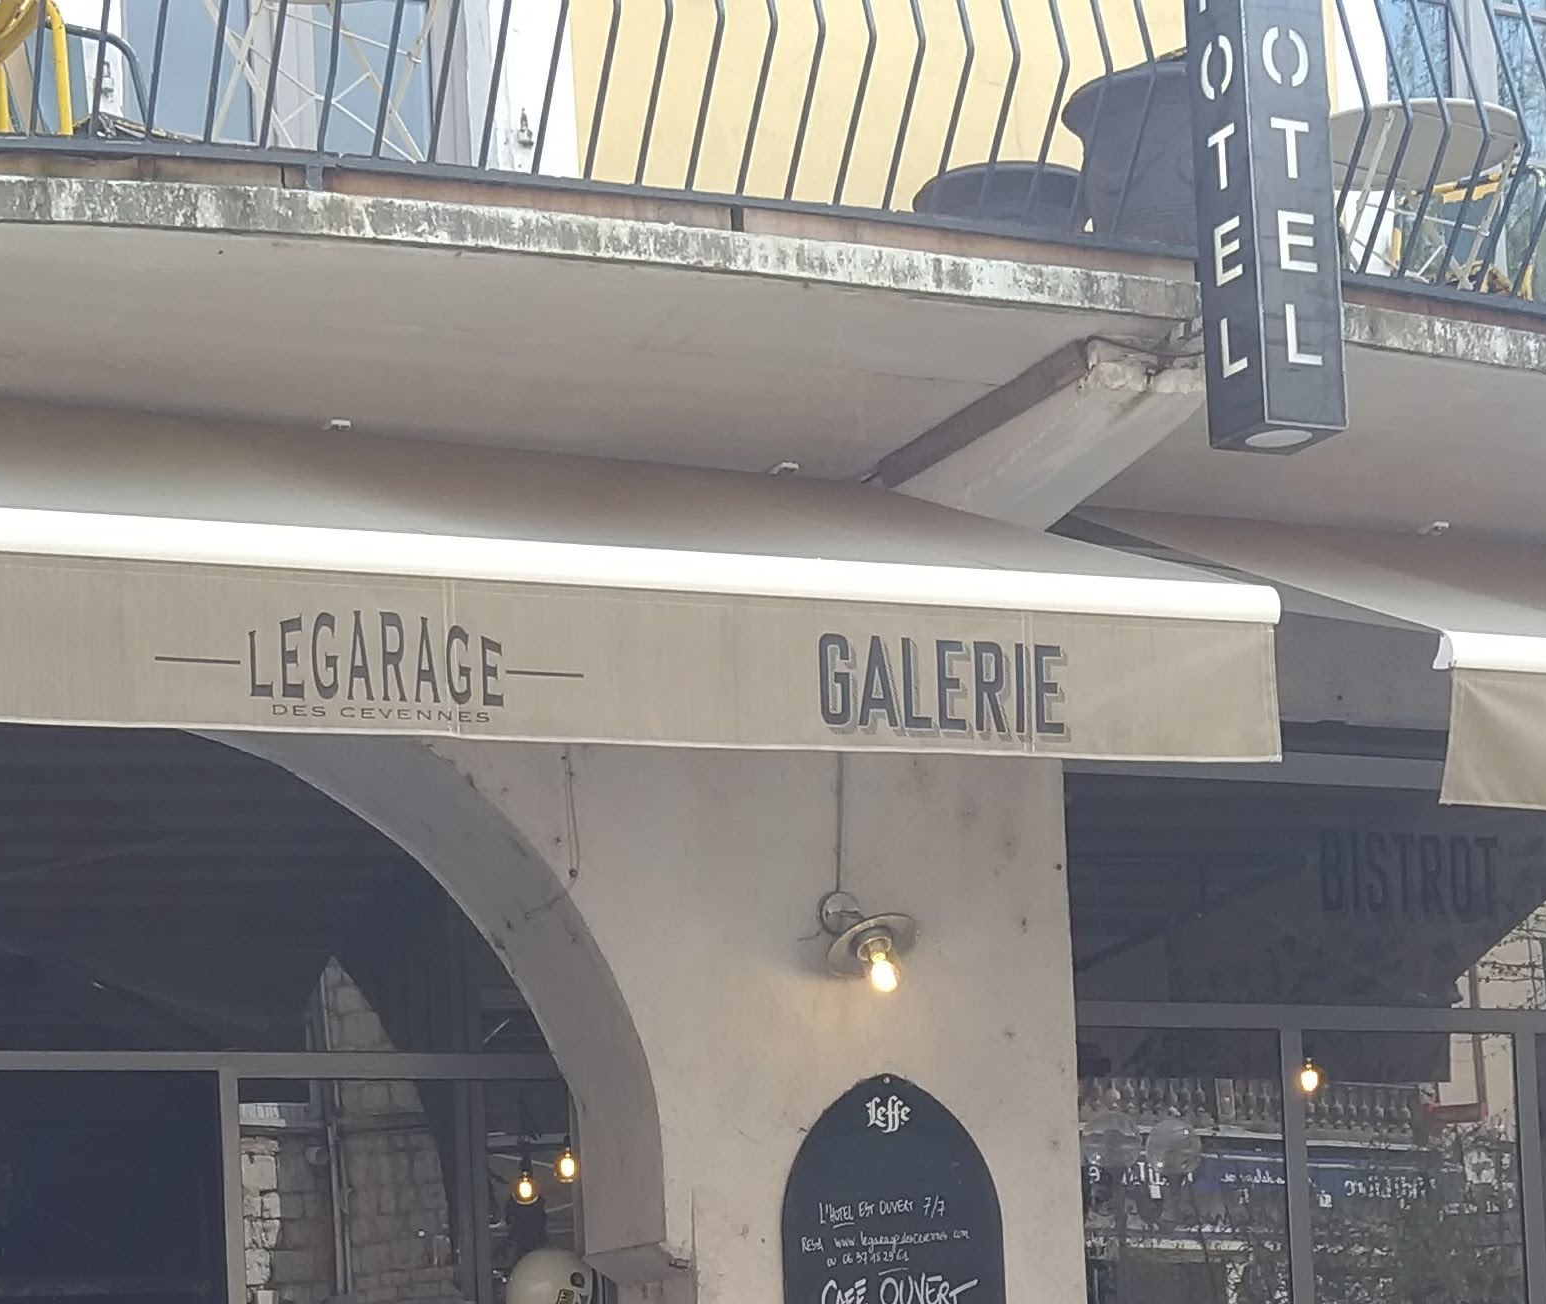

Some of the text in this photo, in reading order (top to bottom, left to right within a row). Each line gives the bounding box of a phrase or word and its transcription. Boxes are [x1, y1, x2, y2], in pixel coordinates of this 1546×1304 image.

[248, 610, 504, 707] LEGARAGE
[818, 632, 1071, 743] GALERIE
[272, 703, 490, 725] DES CEVENNES
[866, 1095, 911, 1133] Leffe
[859, 1201, 875, 1217] EST
[880, 1200, 914, 1215] OUVERT
[923, 1195, 945, 1219] 7/7
